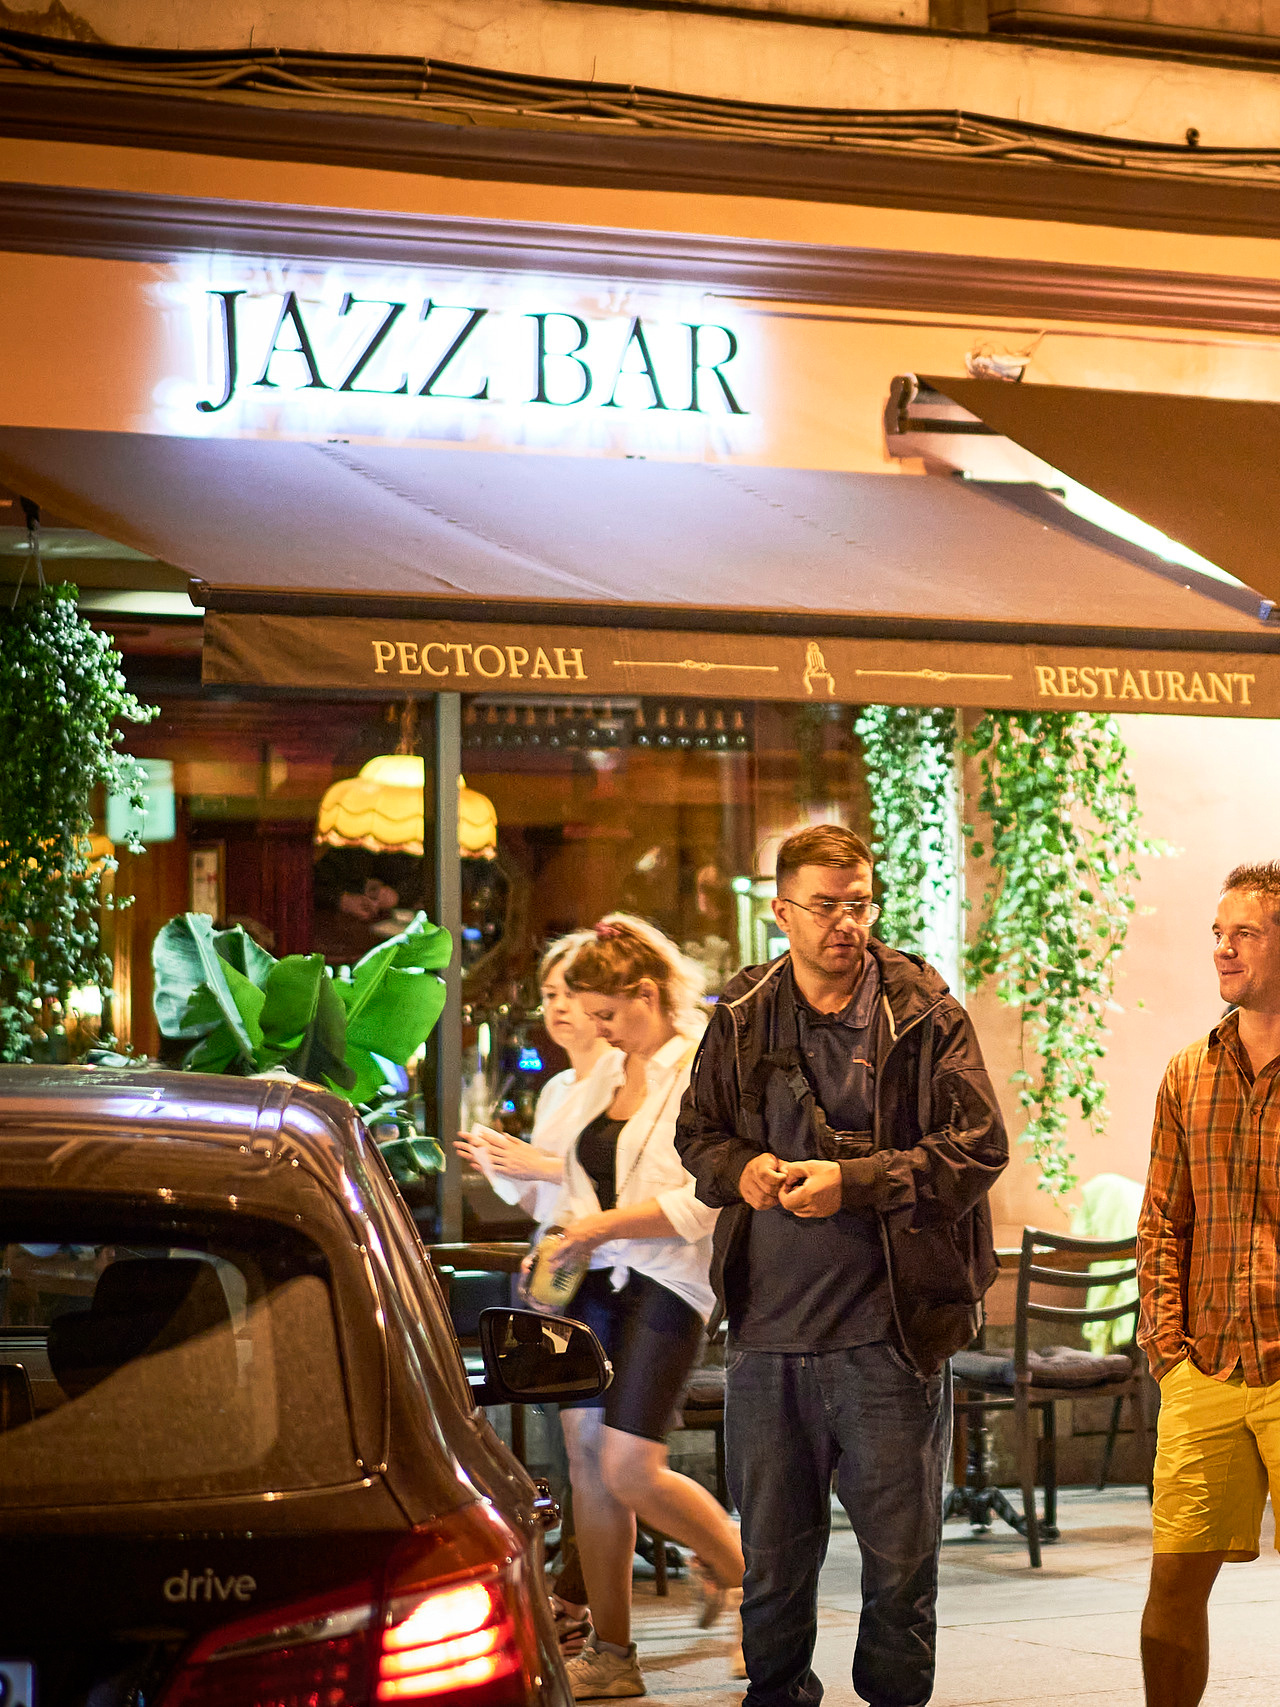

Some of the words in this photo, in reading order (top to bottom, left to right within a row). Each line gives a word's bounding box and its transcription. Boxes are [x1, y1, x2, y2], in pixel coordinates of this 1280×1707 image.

[196, 289, 490, 412] JAZZ
[524, 312, 751, 415] BAR
[371, 640, 588, 680] РЕСТОРАН
[1035, 665, 1256, 705] RESTAURANT
[163, 1567, 257, 1602] drive
